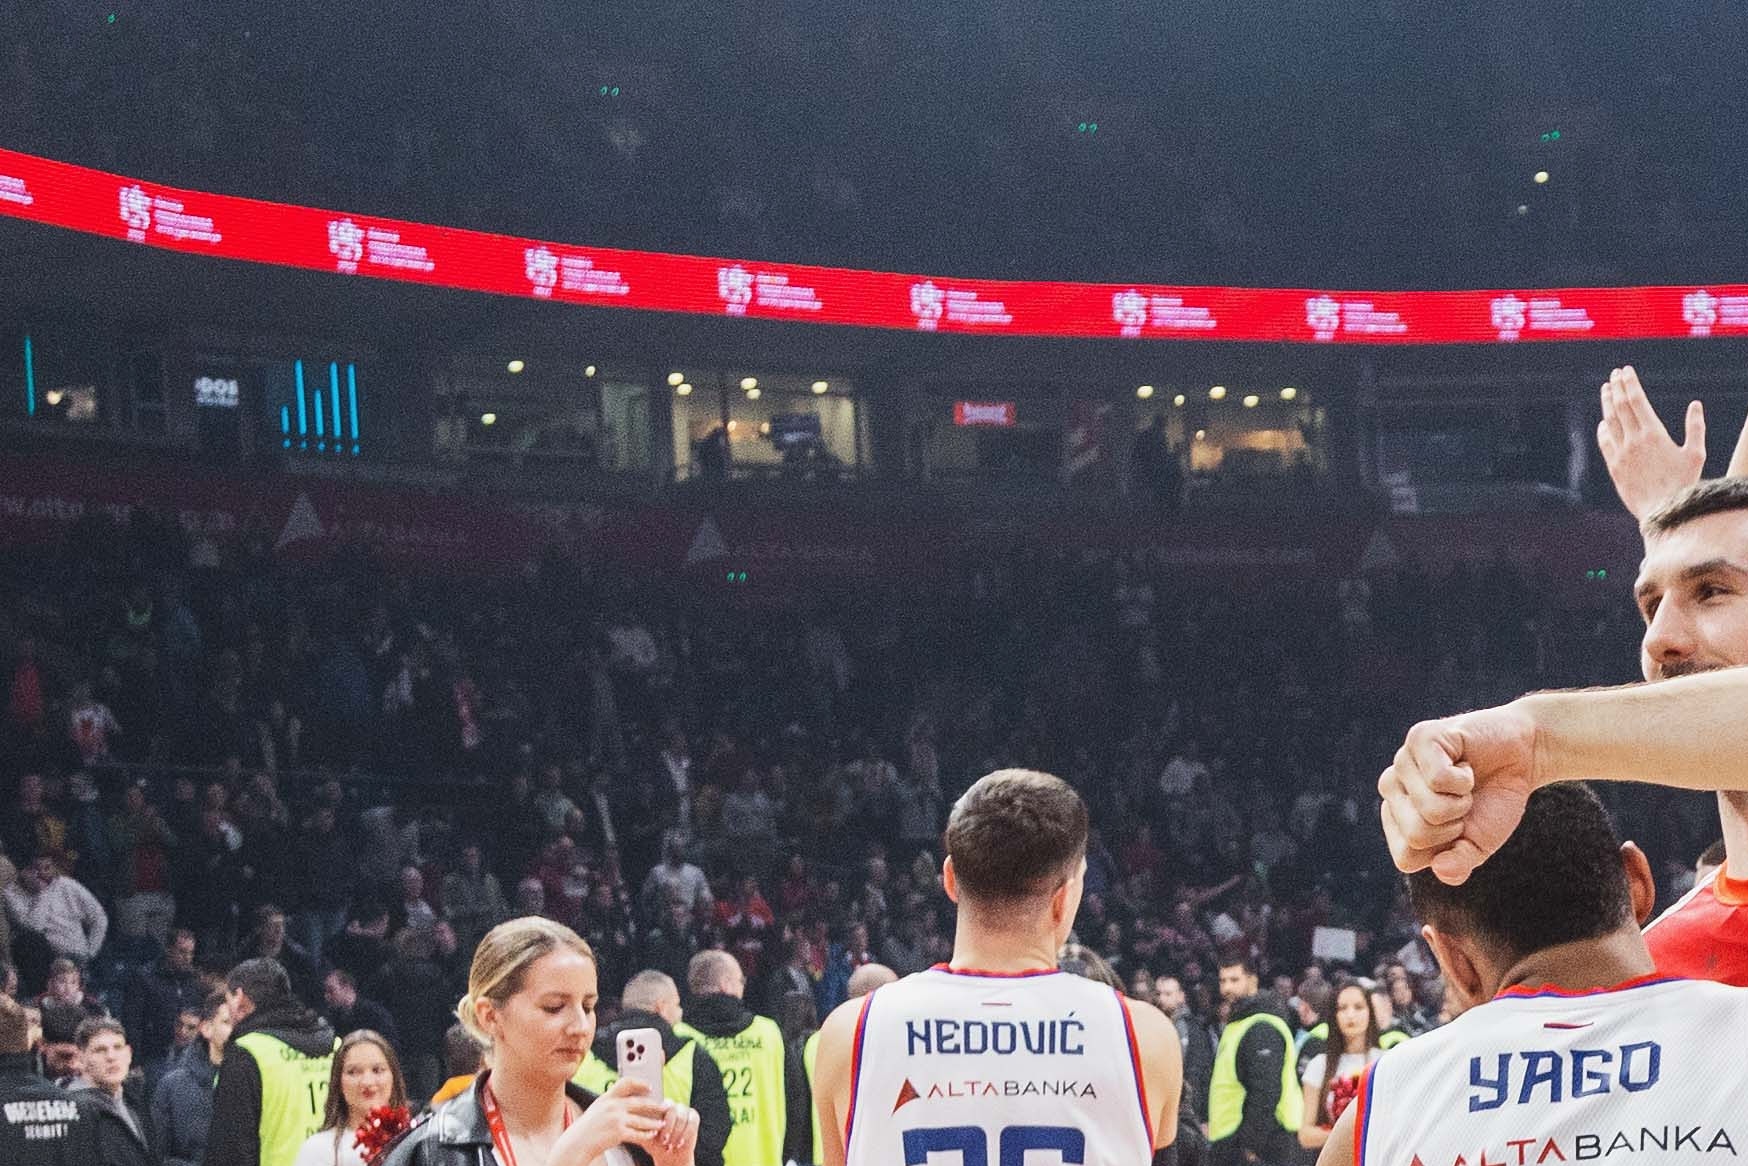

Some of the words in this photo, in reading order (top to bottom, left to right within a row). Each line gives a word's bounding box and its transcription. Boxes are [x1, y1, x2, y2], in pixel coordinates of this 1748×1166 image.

[906, 1011, 1085, 1056] NEDOVIĆ
[927, 1080, 1097, 1100] ALTABANKA
[1468, 1040, 1662, 1113] YAGO
